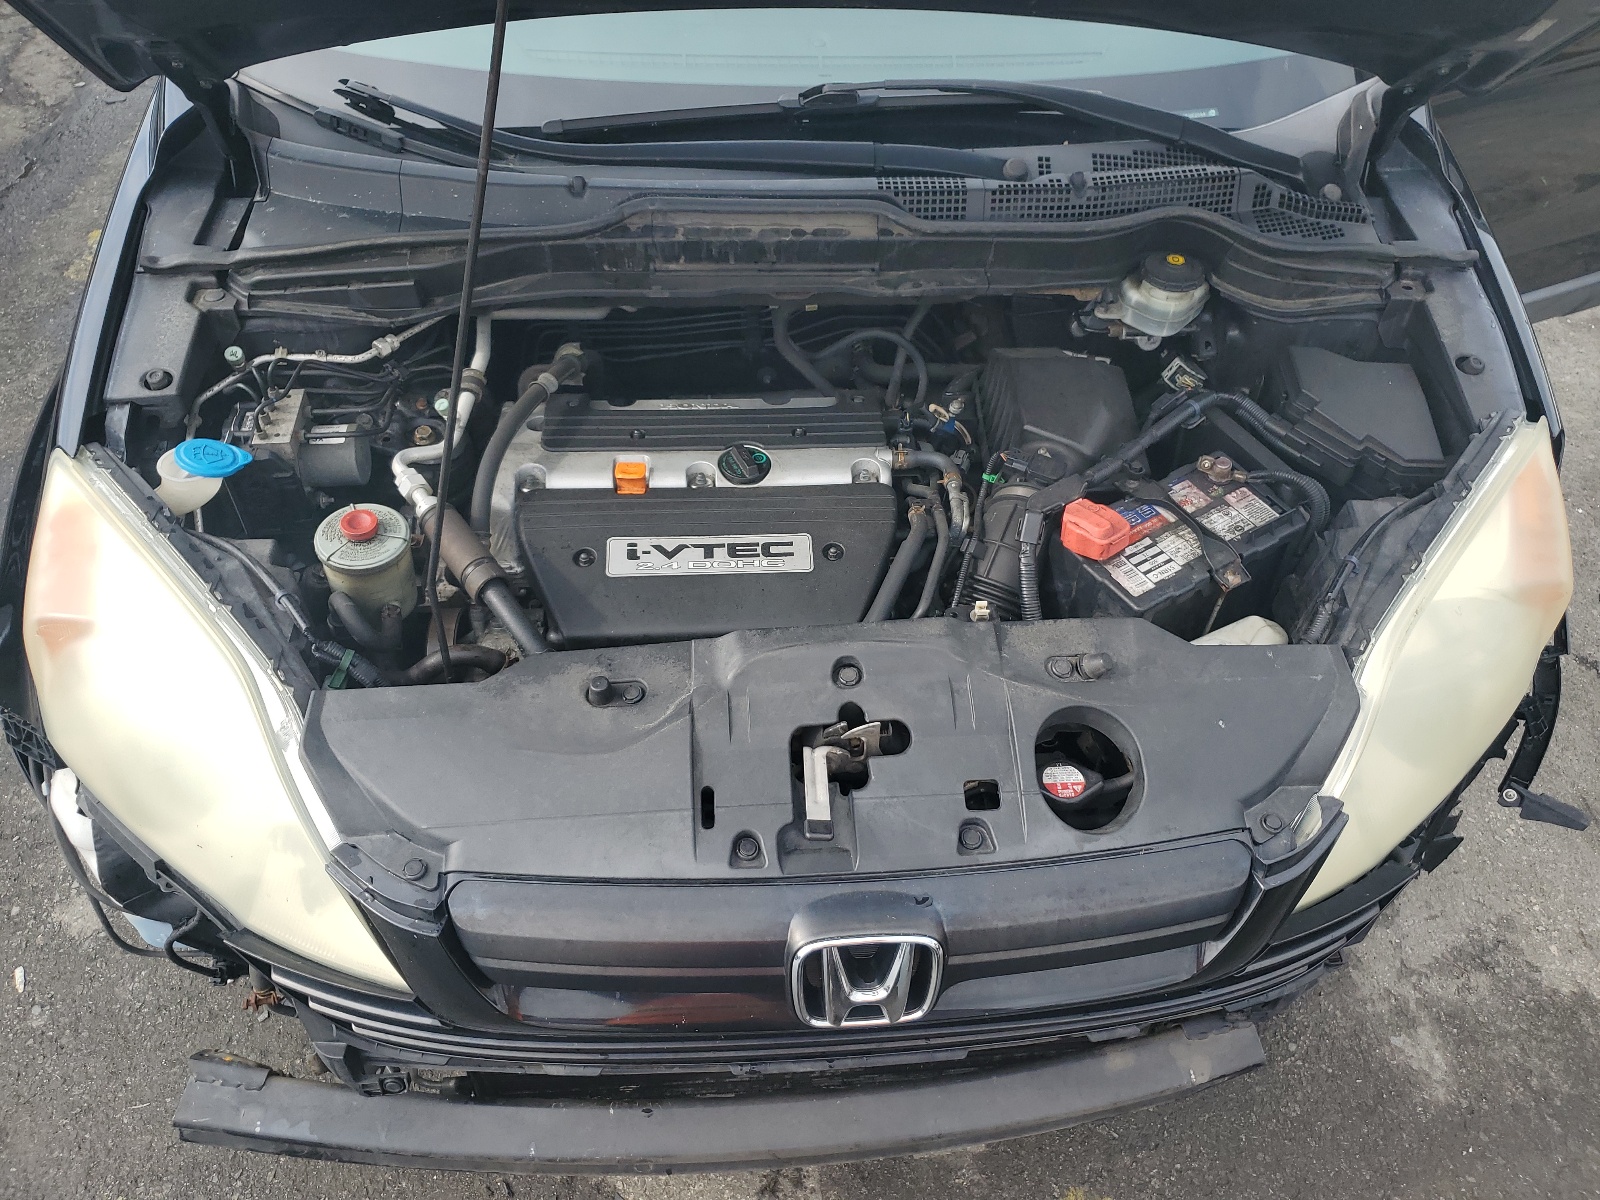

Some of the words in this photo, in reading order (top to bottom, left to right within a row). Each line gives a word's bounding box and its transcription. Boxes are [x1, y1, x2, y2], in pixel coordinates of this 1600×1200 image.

[626, 541, 795, 561] i-VTEC
[635, 561, 681, 571] 2.4
[687, 558, 786, 571] DOHC
